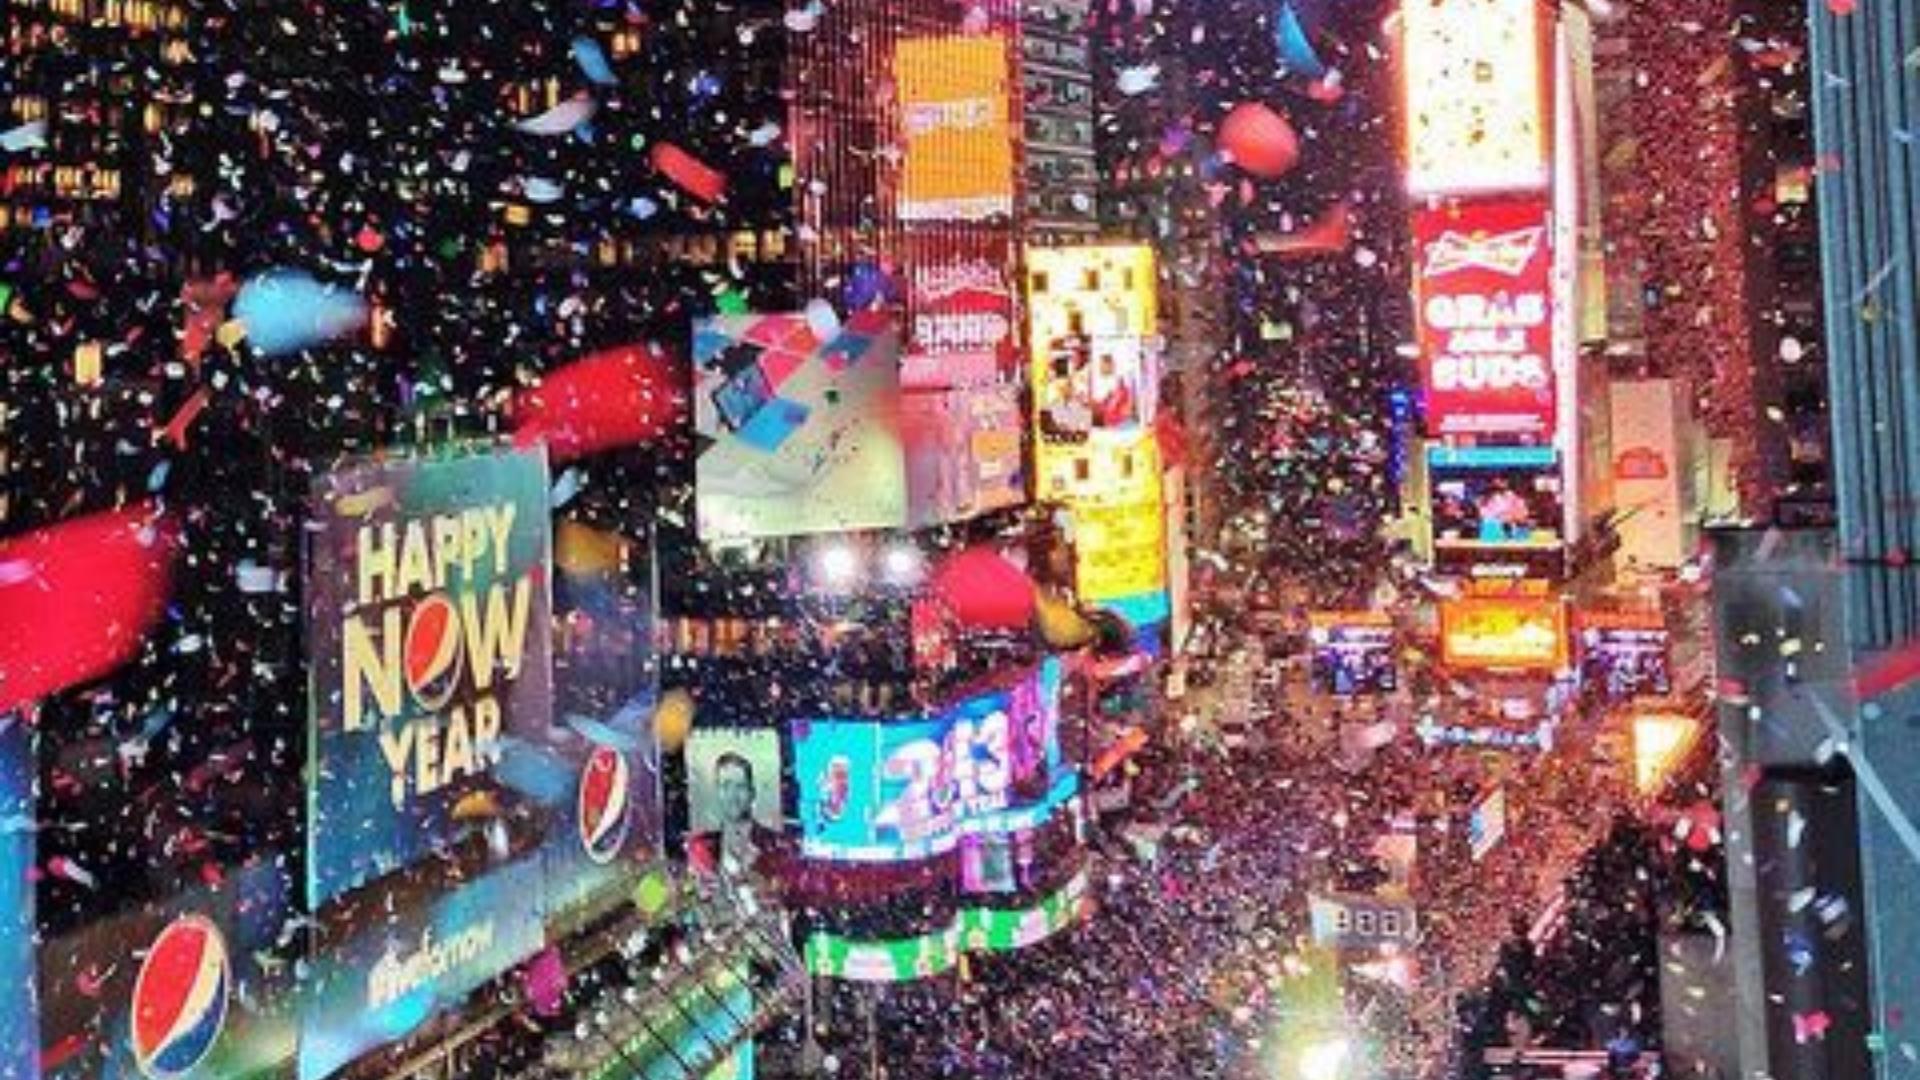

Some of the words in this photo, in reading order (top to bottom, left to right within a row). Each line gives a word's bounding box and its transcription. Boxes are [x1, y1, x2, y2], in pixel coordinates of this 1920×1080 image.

[358, 502, 516, 603] HAPPY
[342, 573, 532, 732] NOW
[379, 697, 502, 812] YEAR
